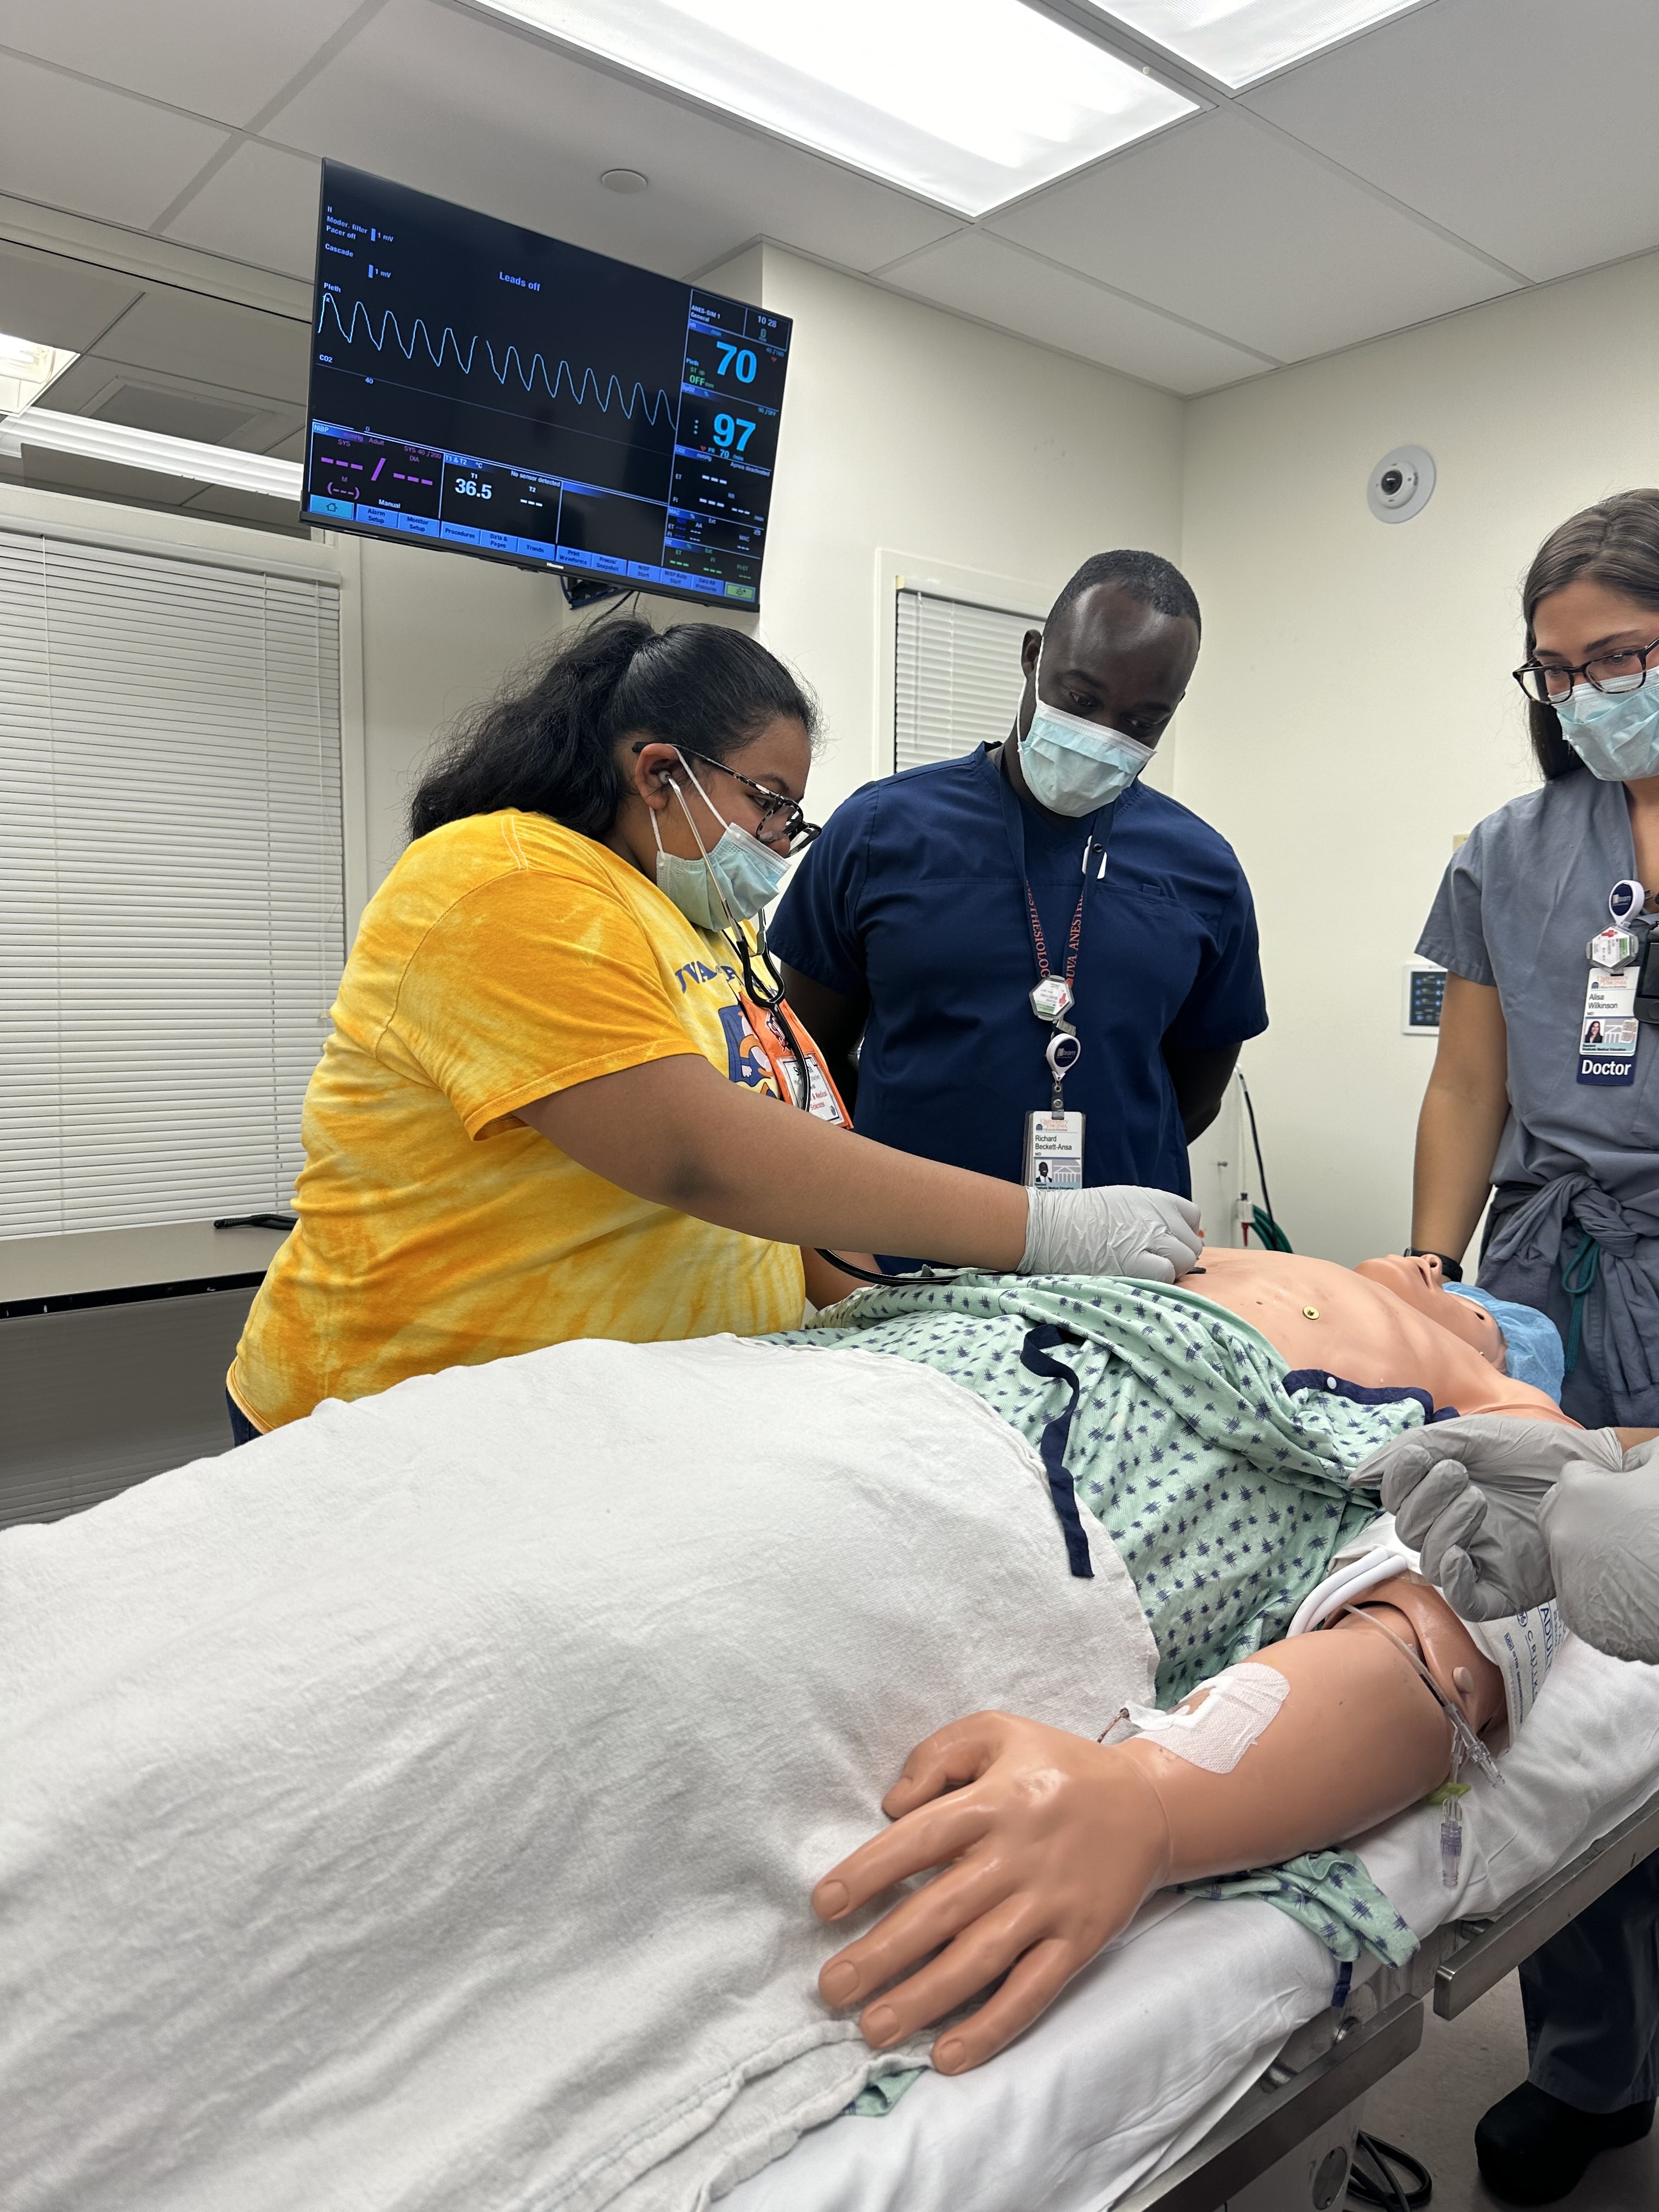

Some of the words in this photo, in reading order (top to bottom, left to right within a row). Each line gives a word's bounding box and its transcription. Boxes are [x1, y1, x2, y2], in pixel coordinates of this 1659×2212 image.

[326, 216, 350, 229] Moder.
[352, 224, 368, 234] filter
[326, 225, 346, 236] Pacer
[325, 244, 354, 257] Cascade
[499, 272, 526, 287] Leads
[528, 281, 540, 291] off
[324, 283, 341, 293] Pleth
[319, 354, 333, 363] CO2
[716, 341, 757, 383] 70
[689, 375, 705, 386] OFF
[314, 424, 329, 433] NIBP
[369, 437, 385, 446] Adult
[713, 413, 757, 452] 97
[338, 439, 351, 447] SYS
[404, 445, 416, 454] SYS
[719, 449, 730, 459] 70
[520, 473, 537, 481] sensor
[538, 475, 561, 487] detected
[455, 478, 492, 500] 36.5
[379, 499, 401, 509] Manual
[368, 508, 386, 517] Alarm
[368, 516, 385, 524] Setup
[407, 517, 429, 526] Monitor
[409, 524, 426, 533] Setup
[445, 527, 476, 539] Procedures
[490, 541, 506, 549] Pages
[526, 544, 544, 553] Trends
[559, 555, 587, 565] Waveforms
[1066, 953, 1077, 978] UVA
[1582, 1059, 1632, 1075] Doctor
